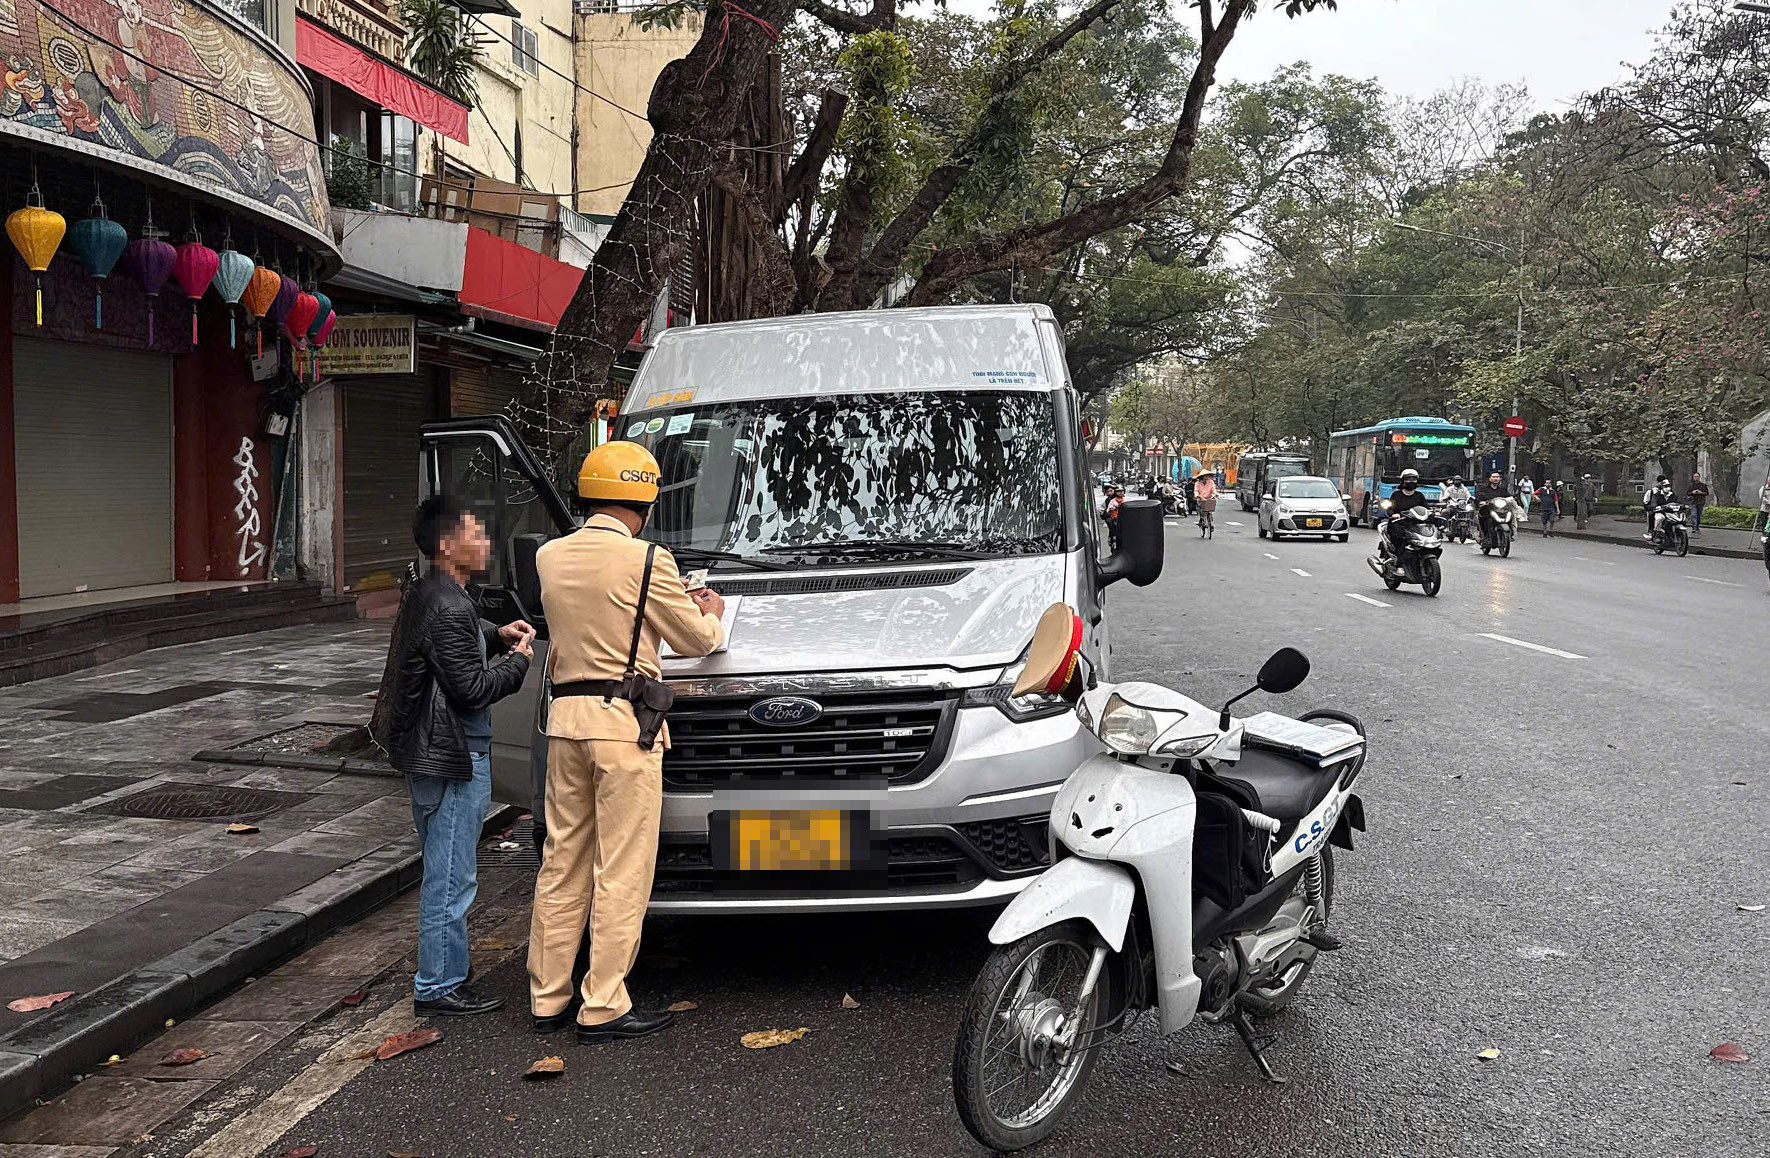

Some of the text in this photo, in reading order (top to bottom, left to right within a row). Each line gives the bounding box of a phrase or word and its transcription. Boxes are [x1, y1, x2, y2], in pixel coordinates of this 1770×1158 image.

[354, 327, 410, 348] SOUVENIR
[620, 469, 656, 485] CSGT
[764, 701, 804, 720] Ford
